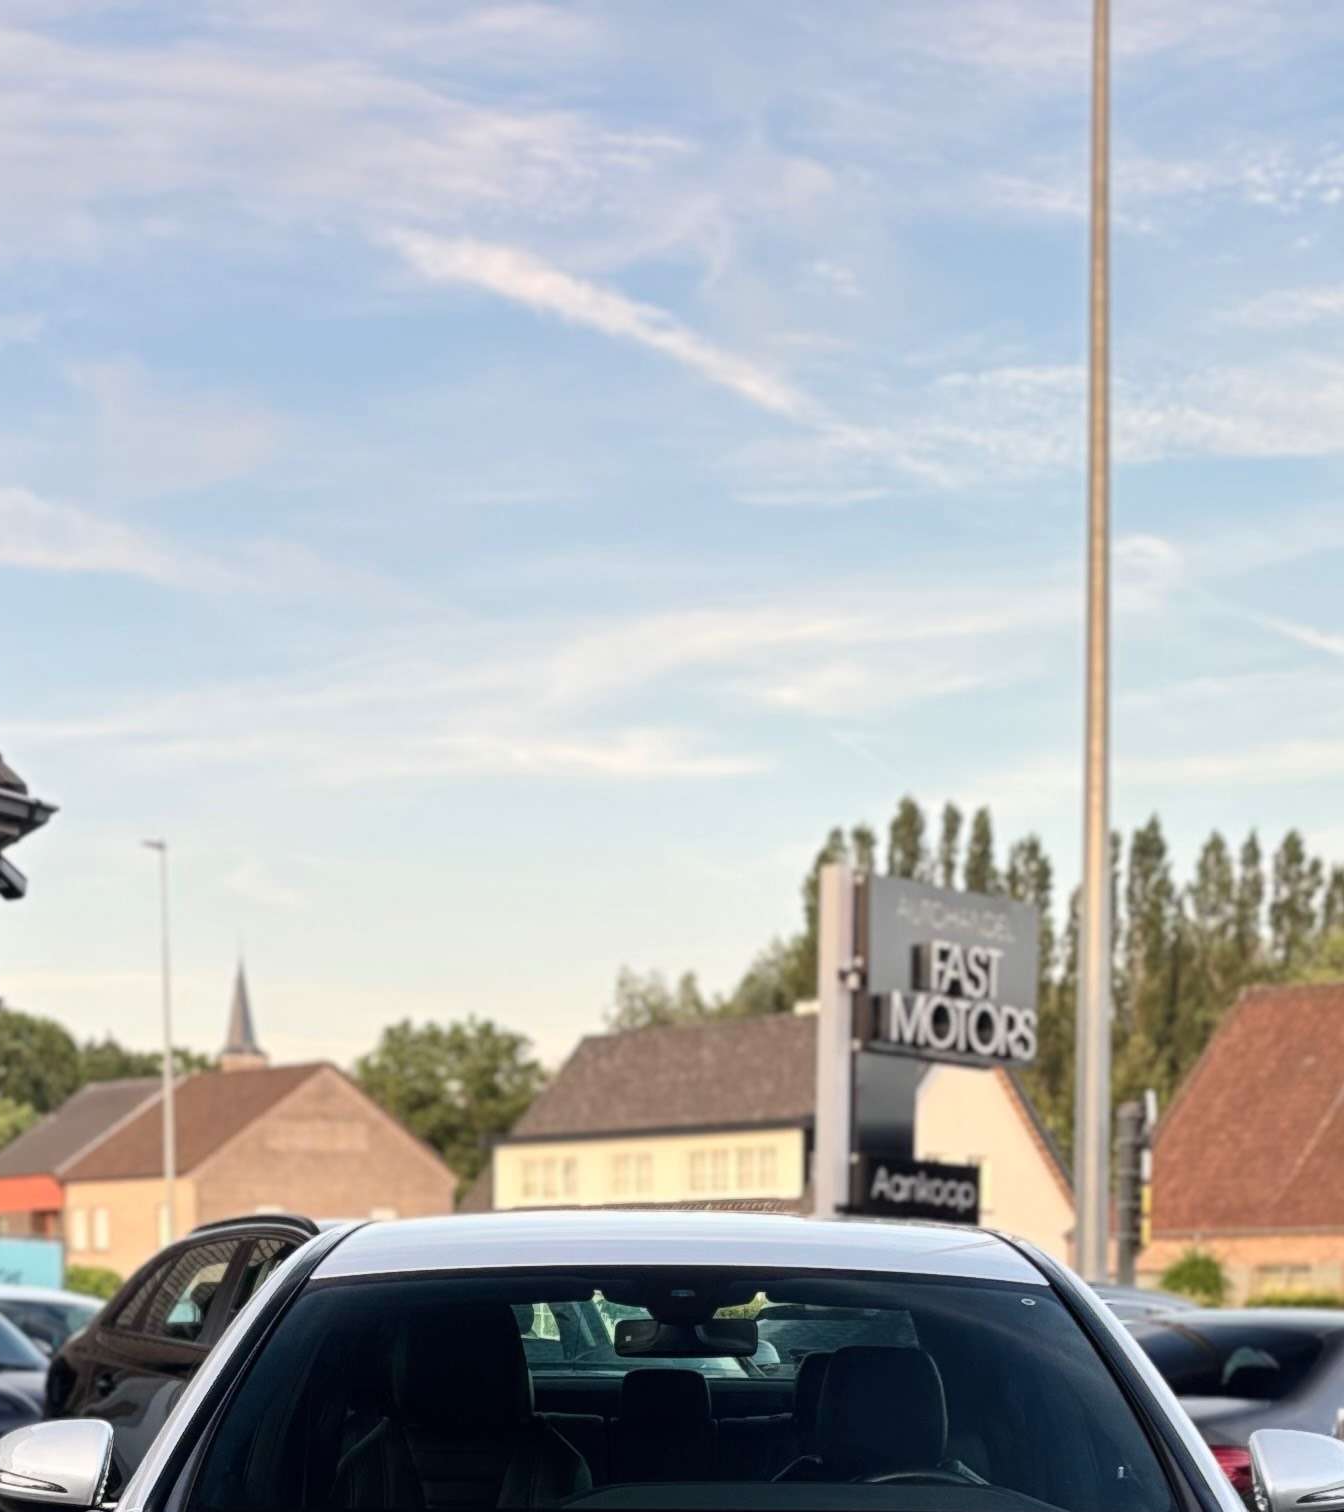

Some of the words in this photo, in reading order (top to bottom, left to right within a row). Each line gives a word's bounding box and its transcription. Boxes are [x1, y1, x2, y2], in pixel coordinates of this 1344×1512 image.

[930, 939, 1003, 999] FAST
[890, 989, 1038, 1061] MOTORS
[870, 1165, 976, 1213] Aankoop
